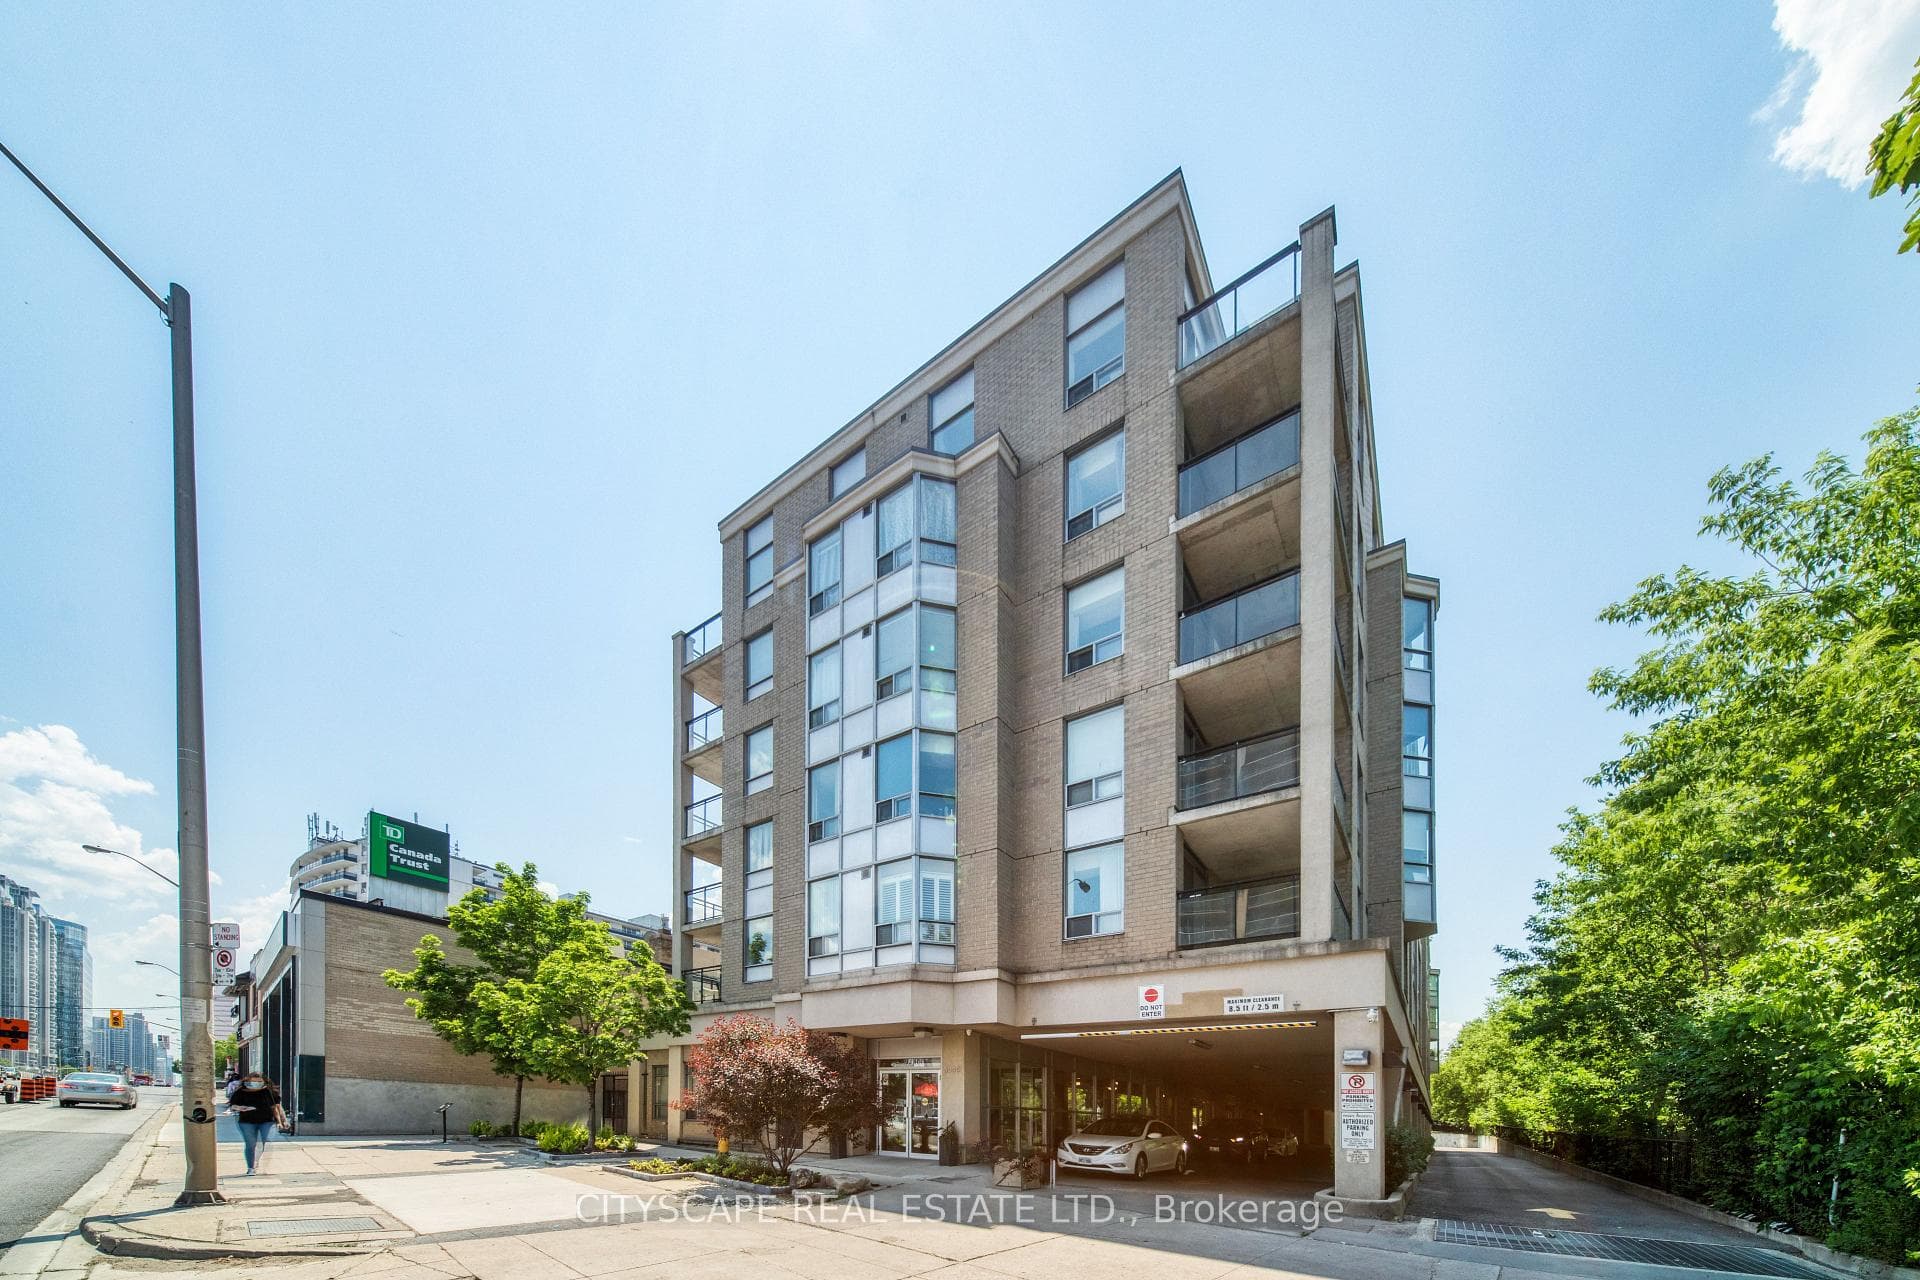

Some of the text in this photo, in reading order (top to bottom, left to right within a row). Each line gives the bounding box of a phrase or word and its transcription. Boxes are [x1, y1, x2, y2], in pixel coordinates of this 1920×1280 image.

[382, 825, 401, 838] TD
[389, 844, 442, 864] Canada
[390, 854, 430, 870] Trust
